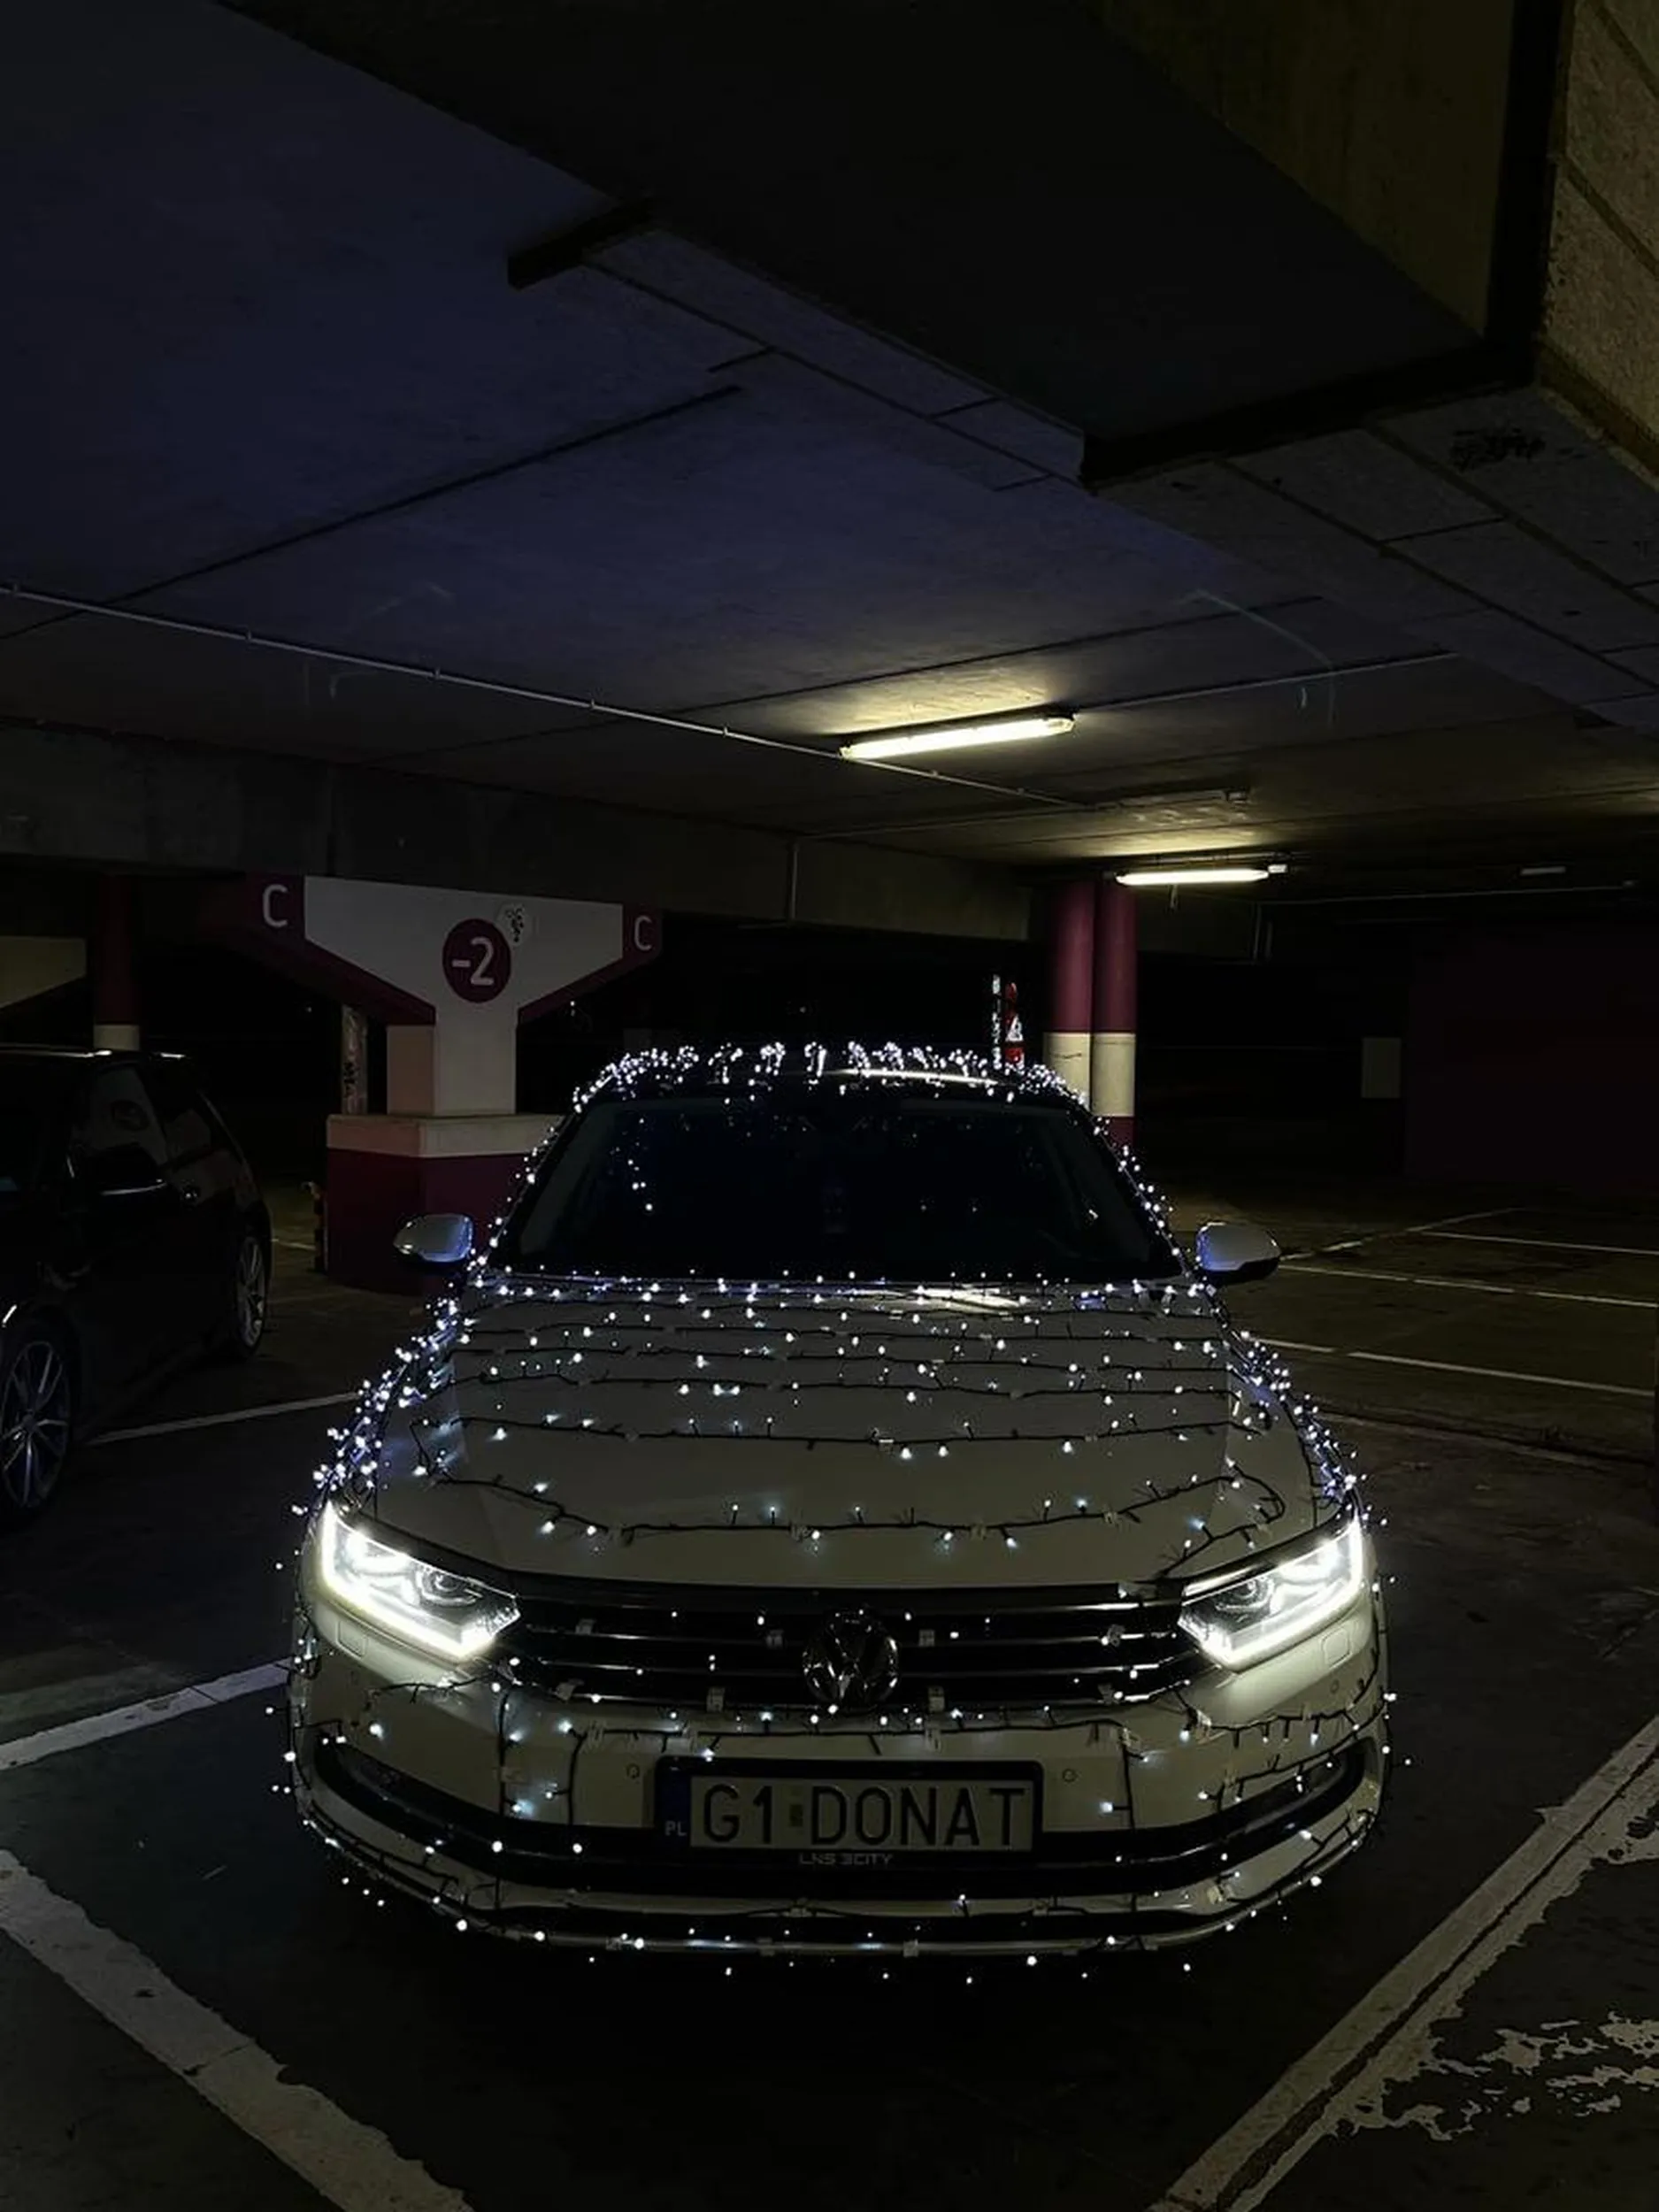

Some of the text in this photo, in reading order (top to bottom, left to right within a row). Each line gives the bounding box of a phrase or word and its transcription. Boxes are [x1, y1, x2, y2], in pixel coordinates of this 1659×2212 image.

[262, 885, 288, 929] C
[633, 915, 653, 951] C
[451, 936, 495, 987] -2
[664, 1820, 687, 1837] PL
[703, 1784, 1025, 1847] G1 DONAT
